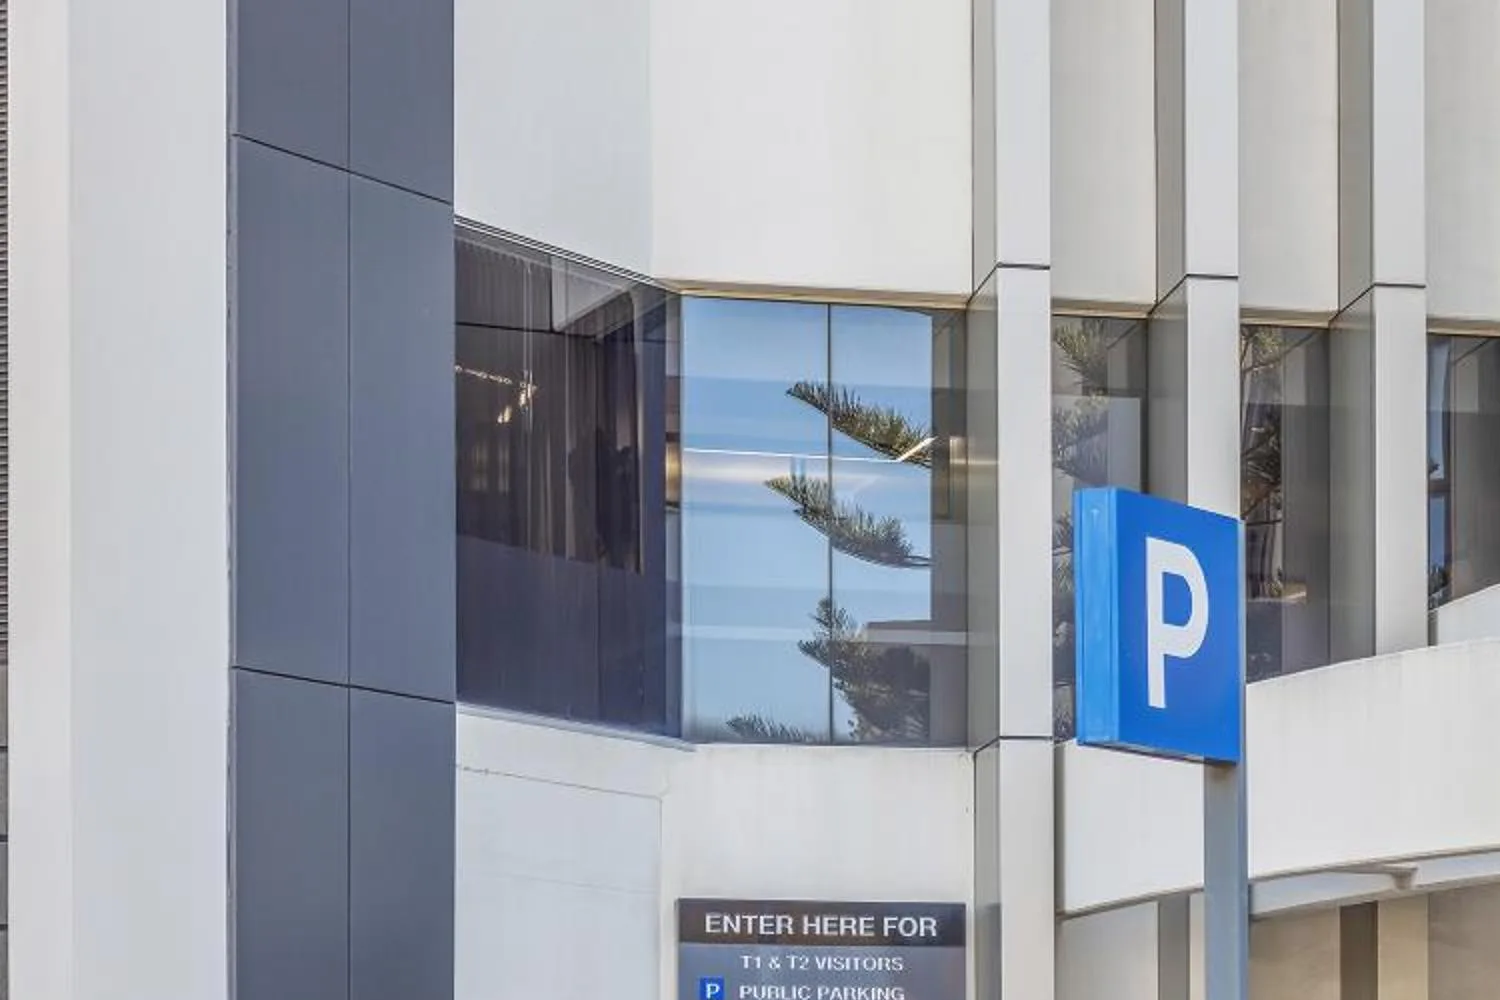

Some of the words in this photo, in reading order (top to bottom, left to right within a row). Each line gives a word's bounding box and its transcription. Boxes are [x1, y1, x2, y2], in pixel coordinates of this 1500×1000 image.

[1145, 536, 1209, 709] P
[704, 912, 793, 936] ENTER
[802, 915, 875, 937] HERE
[882, 916, 938, 937] FOR
[741, 955, 762, 970] T1
[767, 956, 781, 971] &
[786, 955, 810, 971] T2
[815, 956, 904, 972] VISITORS
[705, 983, 721, 999] P
[738, 985, 812, 1000] PUBLIC
[817, 986, 905, 1000] PARKING
